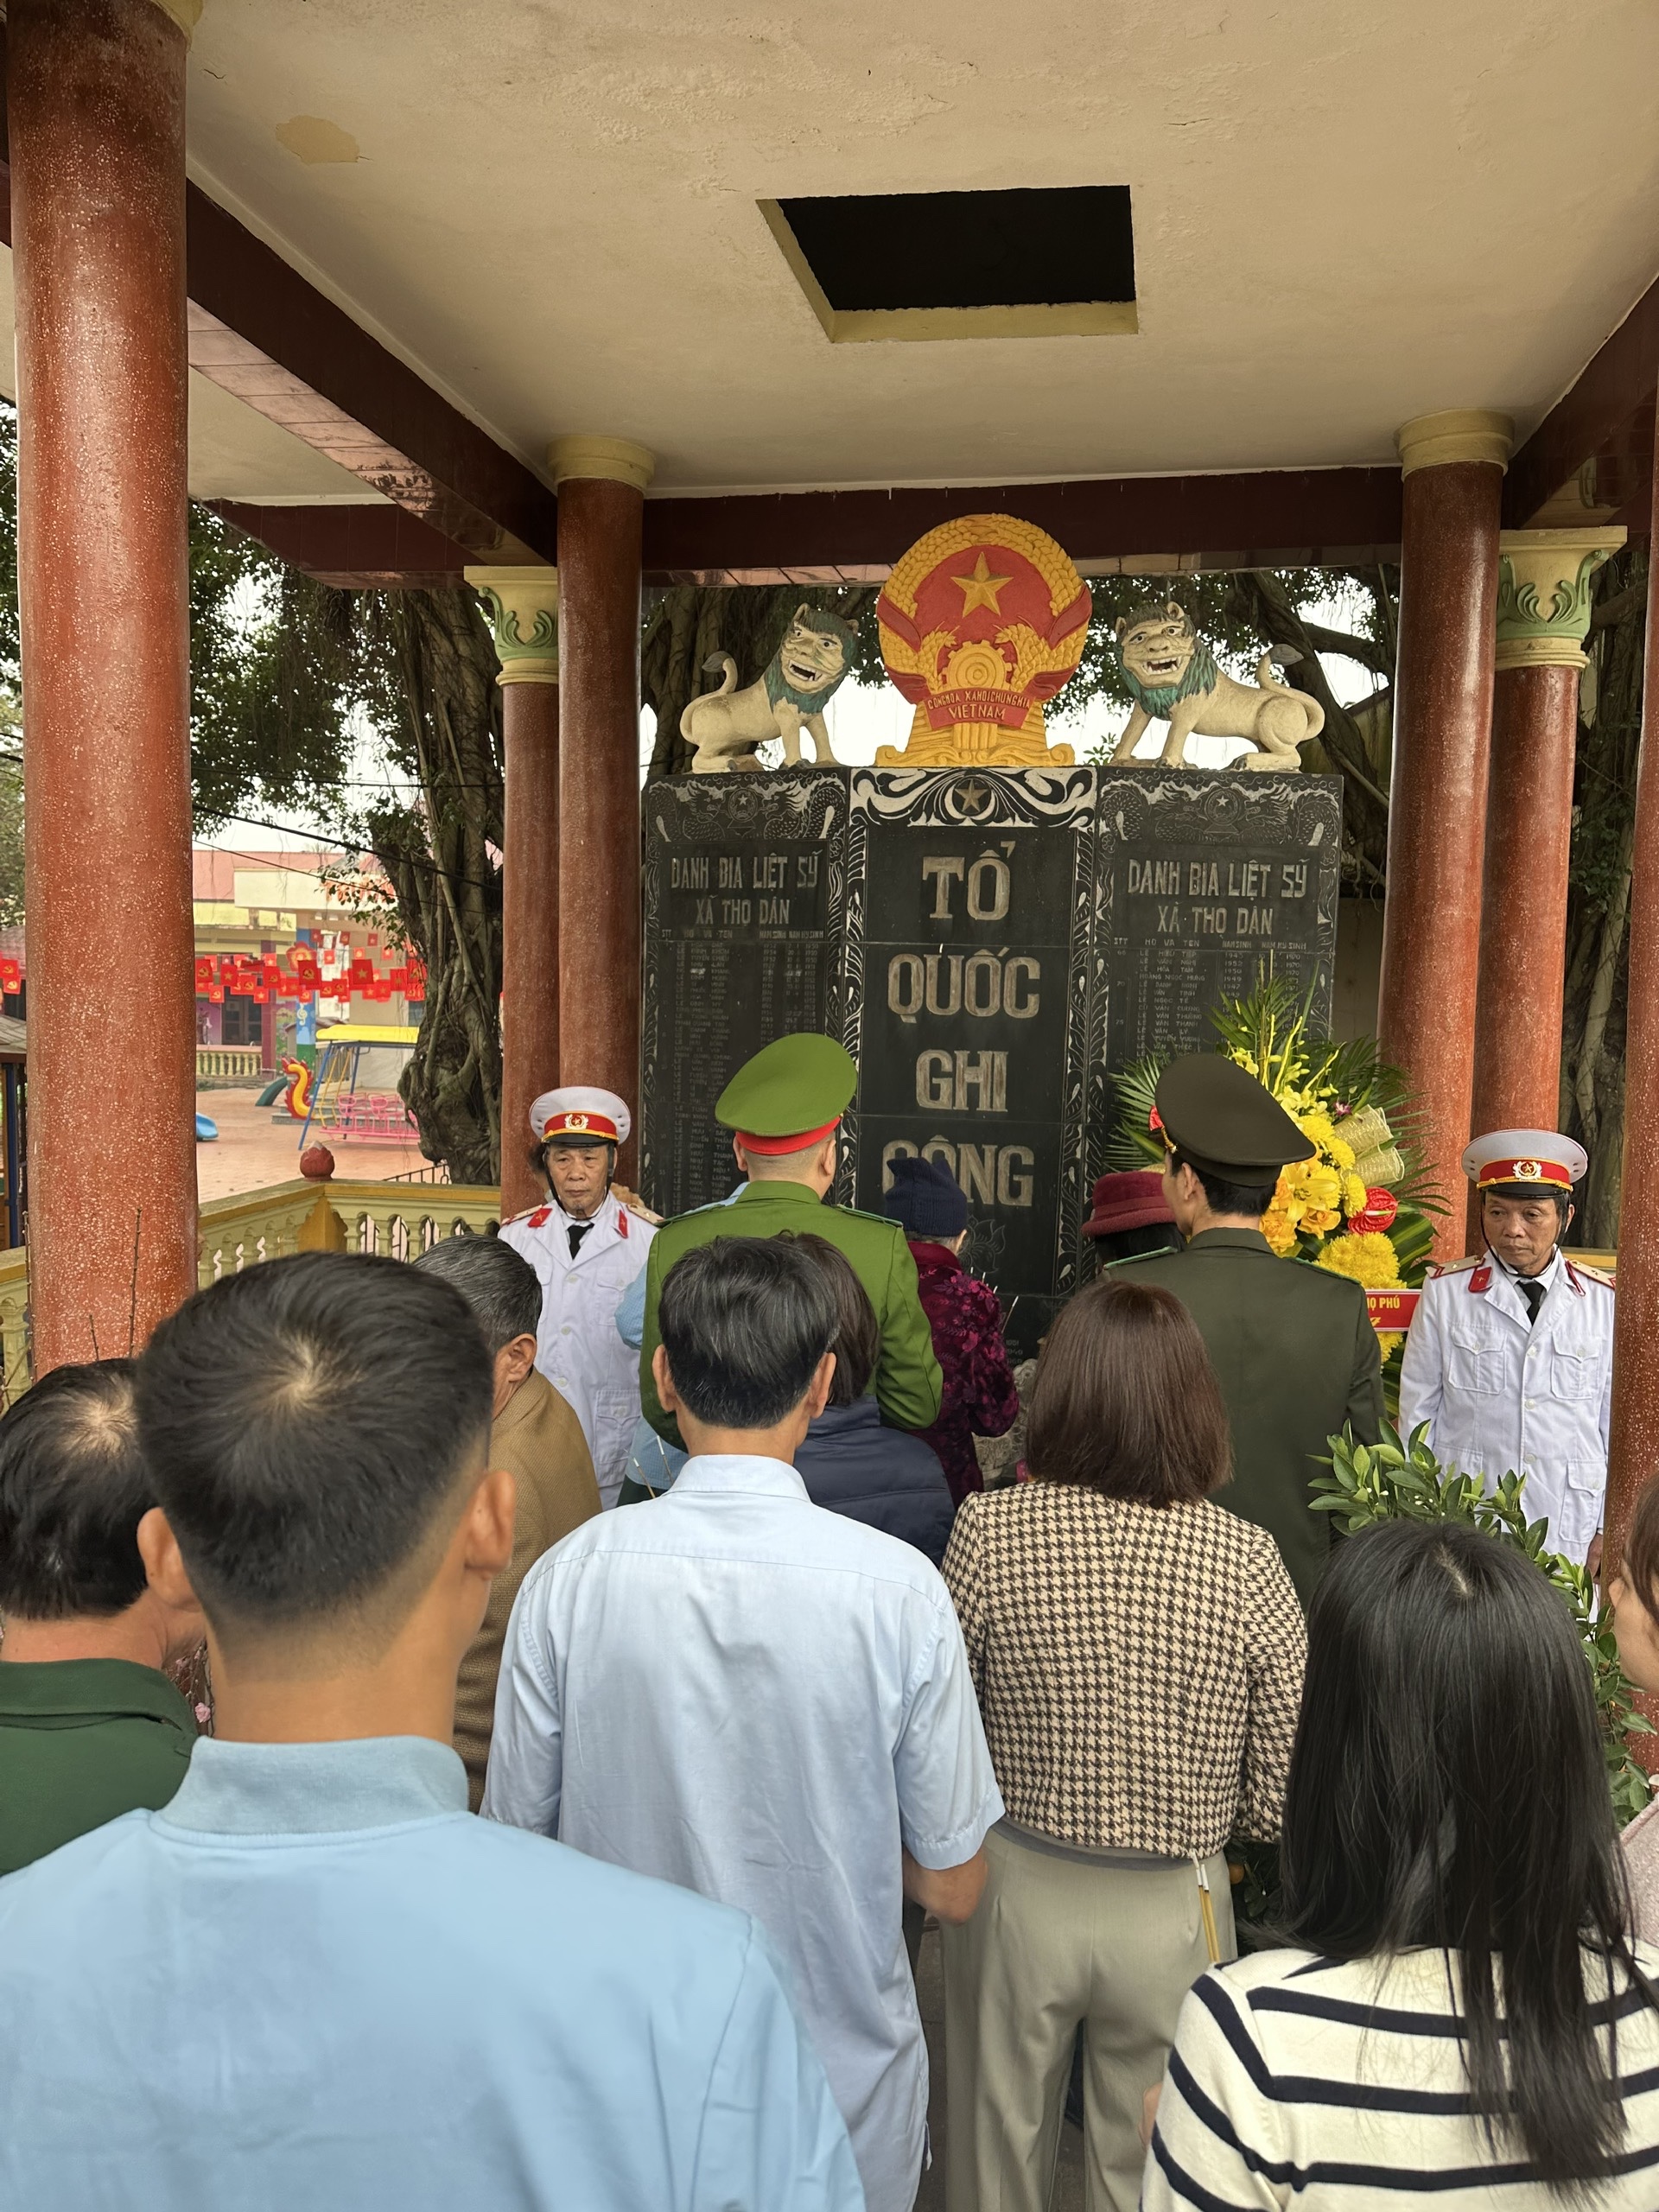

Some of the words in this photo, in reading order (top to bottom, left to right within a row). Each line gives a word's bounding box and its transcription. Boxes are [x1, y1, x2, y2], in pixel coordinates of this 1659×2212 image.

[671, 856, 709, 888] DANH
[719, 856, 743, 888] BIA
[753, 852, 788, 892] LIỆT
[922, 841, 1015, 920] TỔ
[1127, 859, 1181, 895] DANH
[1189, 862, 1220, 896] BIA
[1228, 860, 1271, 901] LIỆT
[760, 896, 791, 925] DÂN
[1236, 906, 1274, 935] DÂN
[887, 947, 1040, 1024] QUỐC
[916, 1049, 1009, 1112] GHI
[1379, 1294, 1401, 1309] PHÚ
